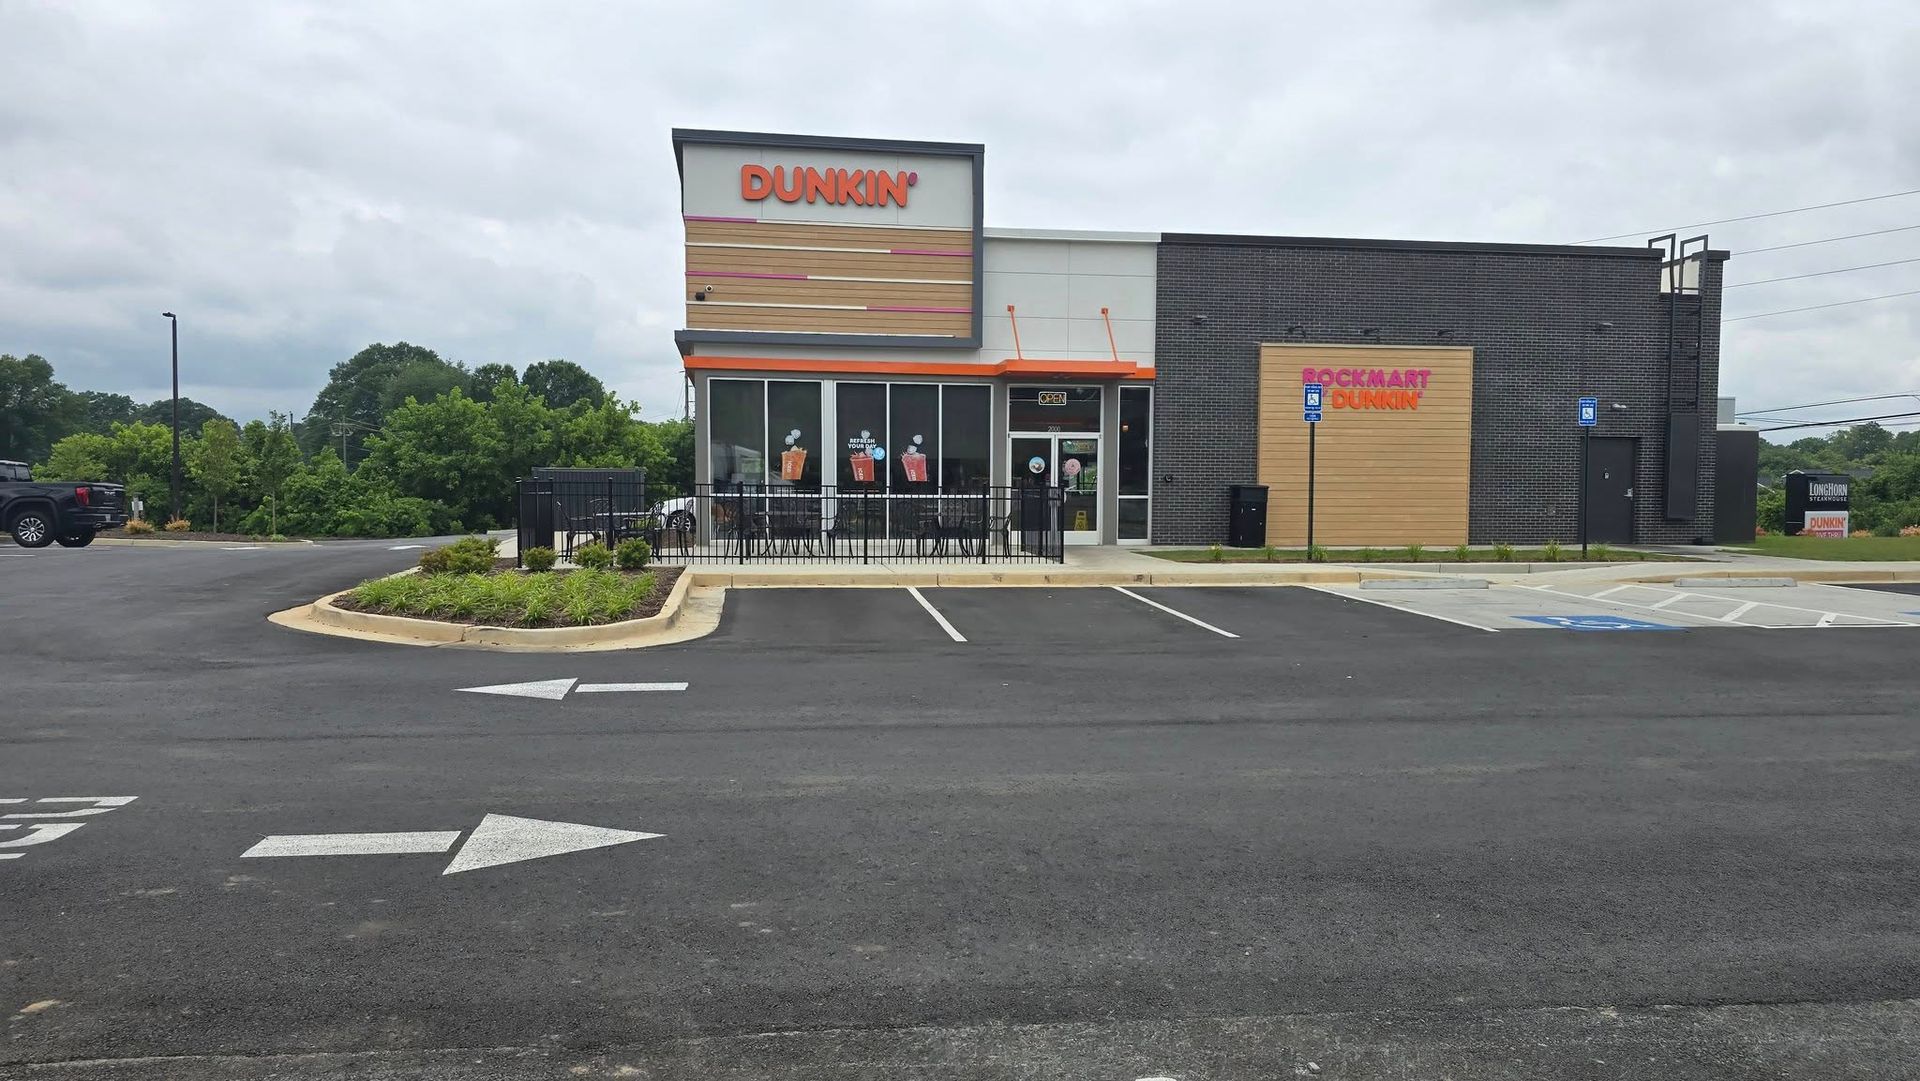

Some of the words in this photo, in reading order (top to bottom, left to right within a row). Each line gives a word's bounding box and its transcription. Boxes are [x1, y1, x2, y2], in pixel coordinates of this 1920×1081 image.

[741, 164, 918, 208] DUNKIN'
[1302, 367, 1431, 388] ROCKMART
[1040, 394, 1065, 403] OPEN
[1332, 389, 1423, 410] DUNKIN'
[1811, 517, 1845, 529] DUNKIN'
